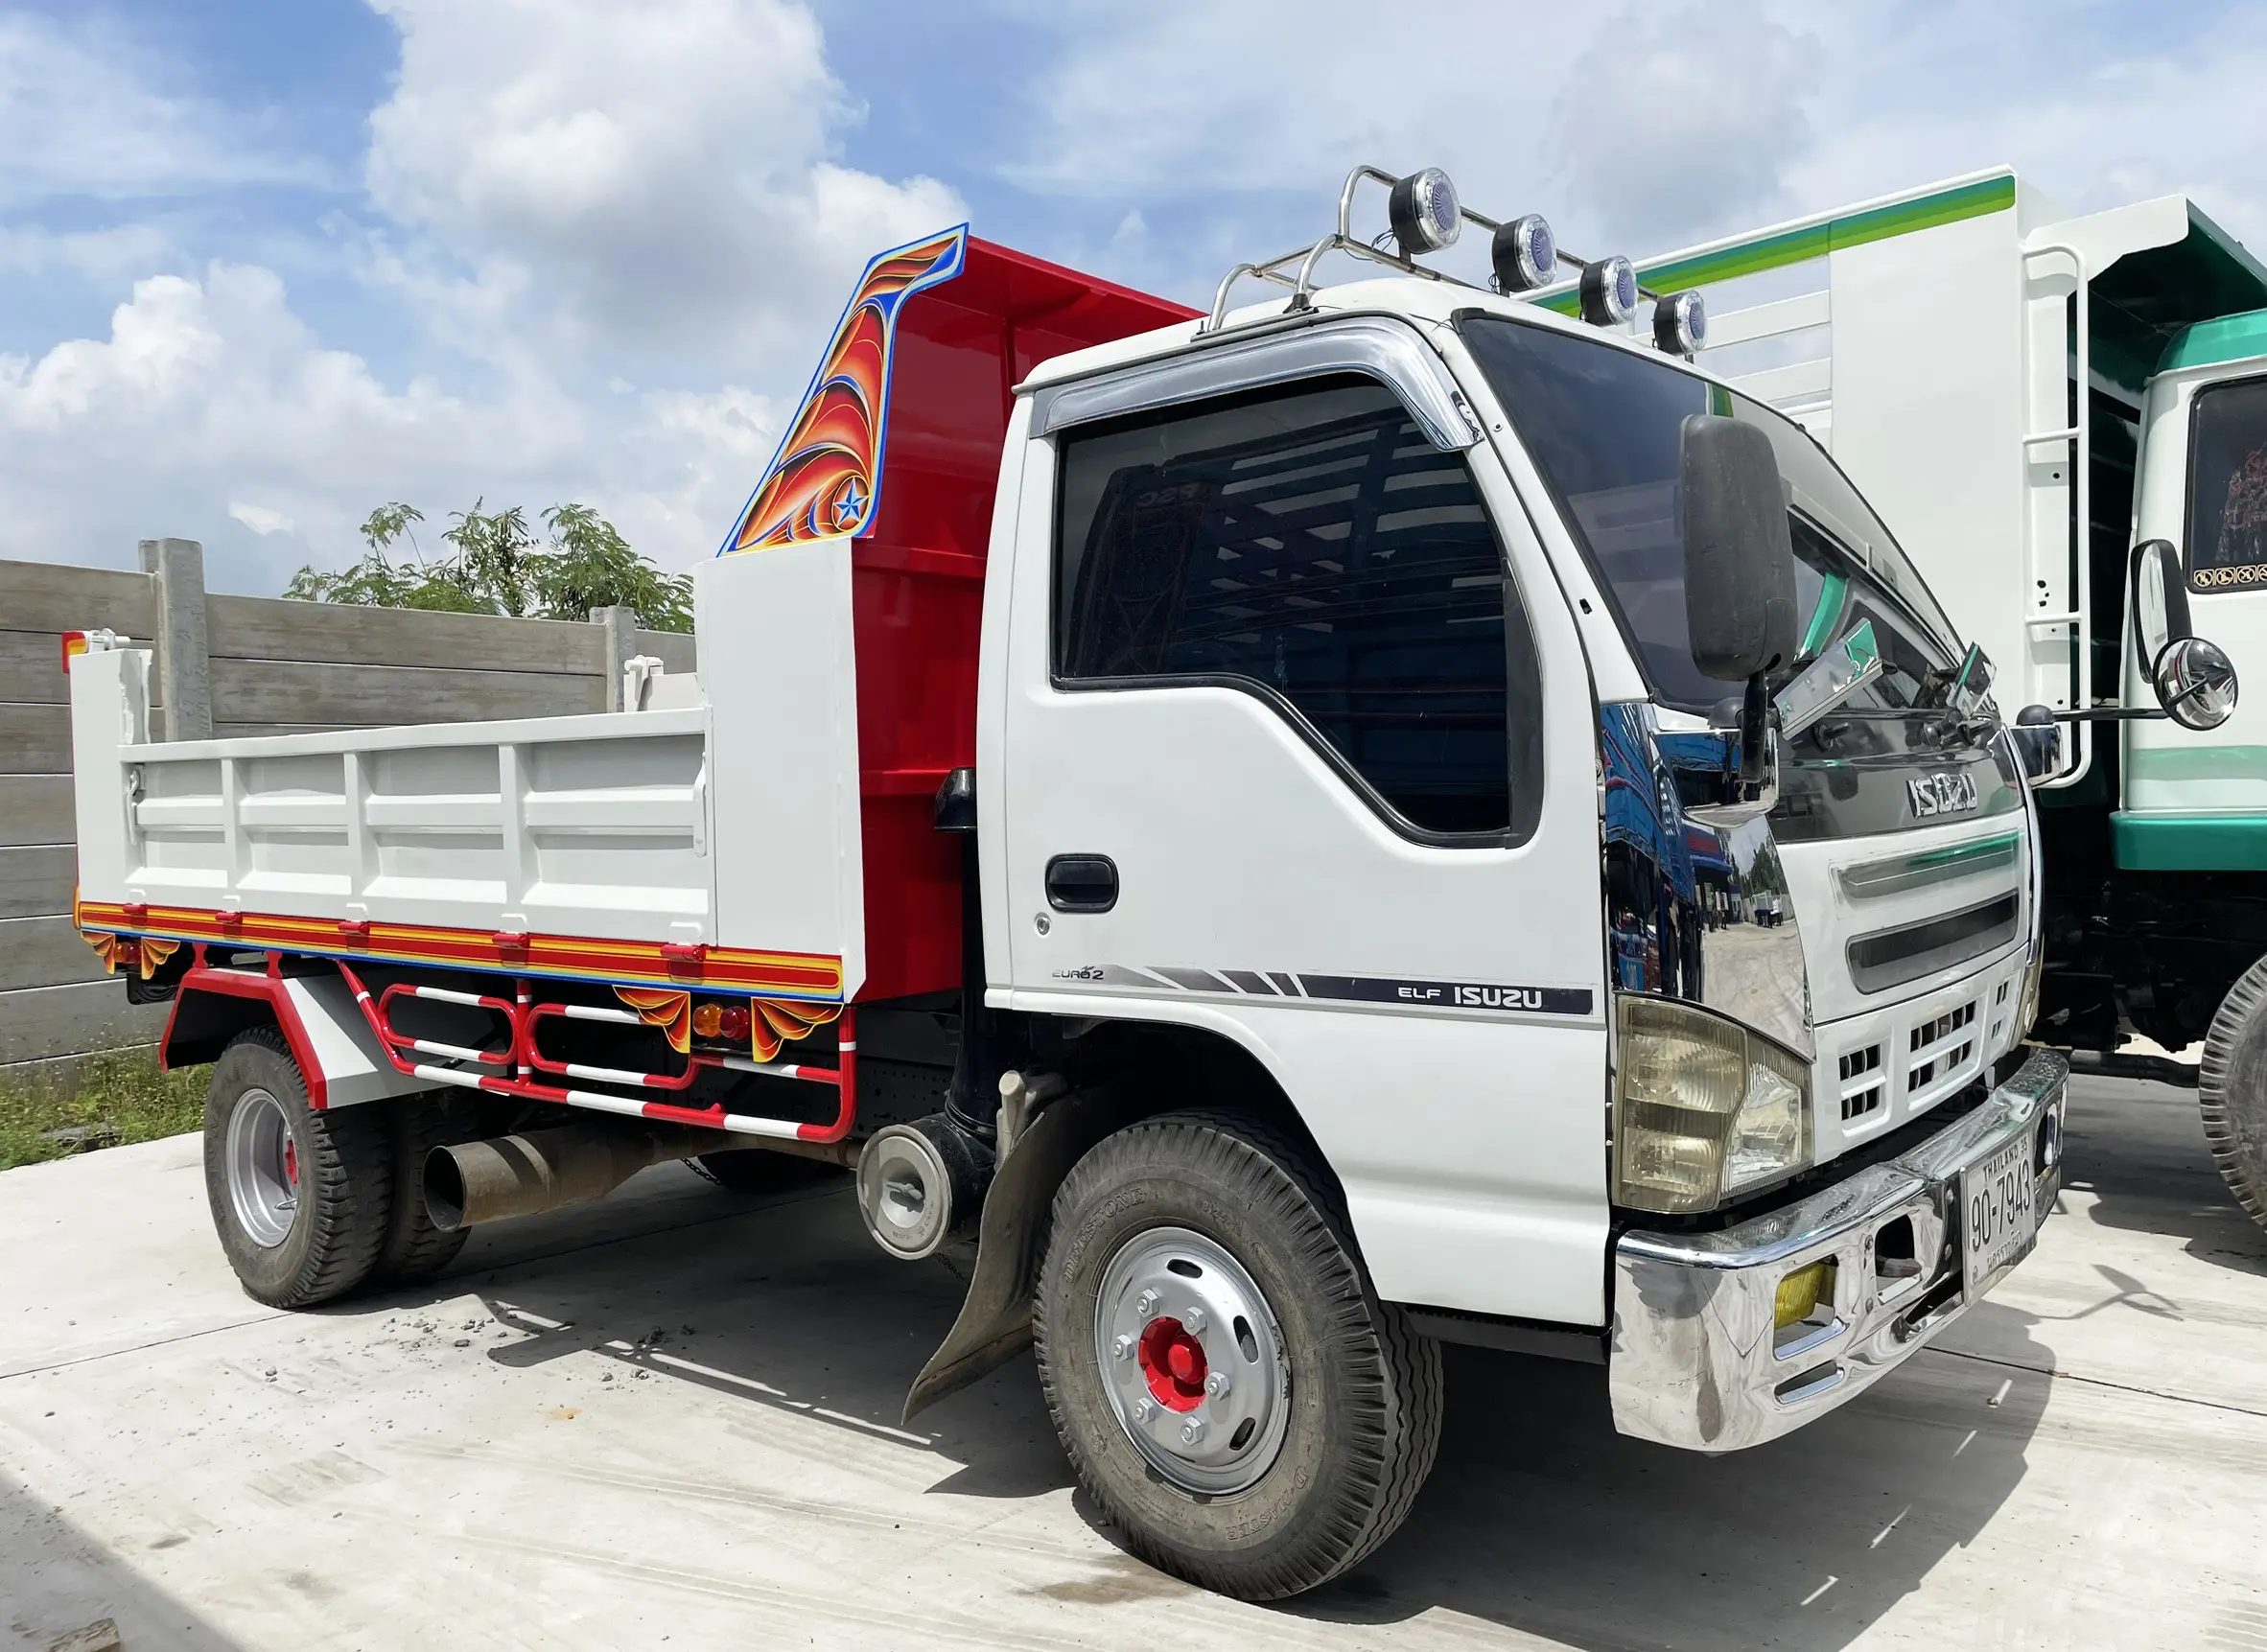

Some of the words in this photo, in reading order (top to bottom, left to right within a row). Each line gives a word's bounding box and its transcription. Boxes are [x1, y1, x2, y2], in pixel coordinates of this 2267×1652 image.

[1906, 773, 1978, 819] ISUZU
[1397, 987, 1441, 999] ELF
[1454, 987, 1543, 1009] ISUZU
[1983, 1144, 2019, 1182] THAILAND
[1971, 1158, 2031, 1253] 90-7943
[1225, 1465, 1309, 1541] D-MASTER
